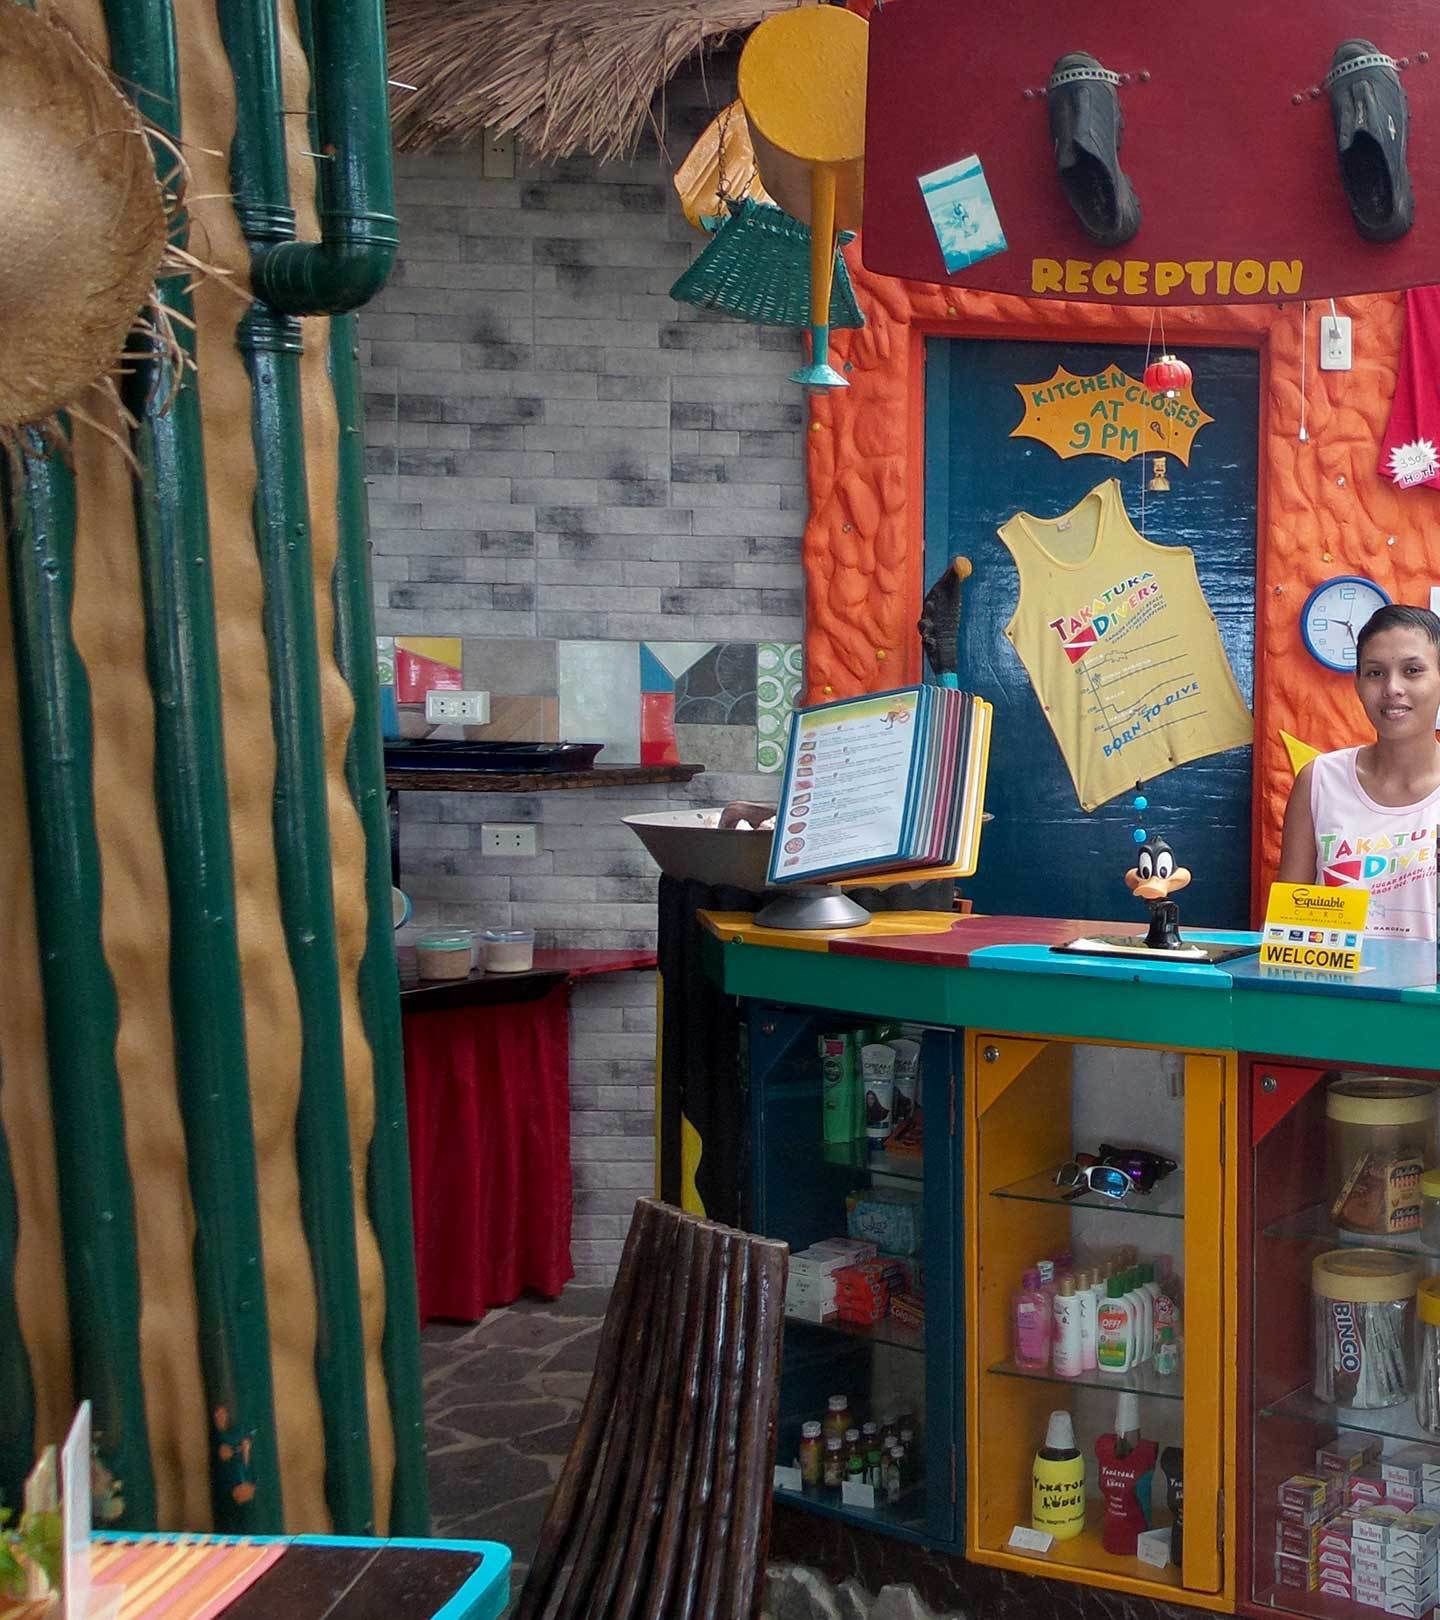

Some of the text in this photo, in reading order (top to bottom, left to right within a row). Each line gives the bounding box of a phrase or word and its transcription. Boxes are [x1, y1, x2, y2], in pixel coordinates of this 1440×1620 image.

[1031, 258, 1303, 296] RECEPTION
[1032, 372, 1200, 430] KITCHEN CLOSES
[1090, 399, 1124, 421] AT
[1069, 422, 1138, 451] 9 PM
[1401, 463, 1435, 484] HOT!
[1050, 571, 1154, 642] TAKATUKA
[1092, 582, 1159, 637] DIVERS
[1313, 618, 1328, 632] 9
[1103, 681, 1199, 757] BORN TO DIVE
[1320, 829, 1437, 863] TAKATU
[1363, 847, 1437, 879] DIVE
[1292, 888, 1345, 909] Equitable
[1371, 879, 1398, 890] SUGAR
[1267, 945, 1355, 969] WELCOME
[1102, 1318, 1128, 1330] OFF!
[1333, 1302, 1361, 1373] BINGO
[1033, 1476, 1085, 1494] TAKATU
